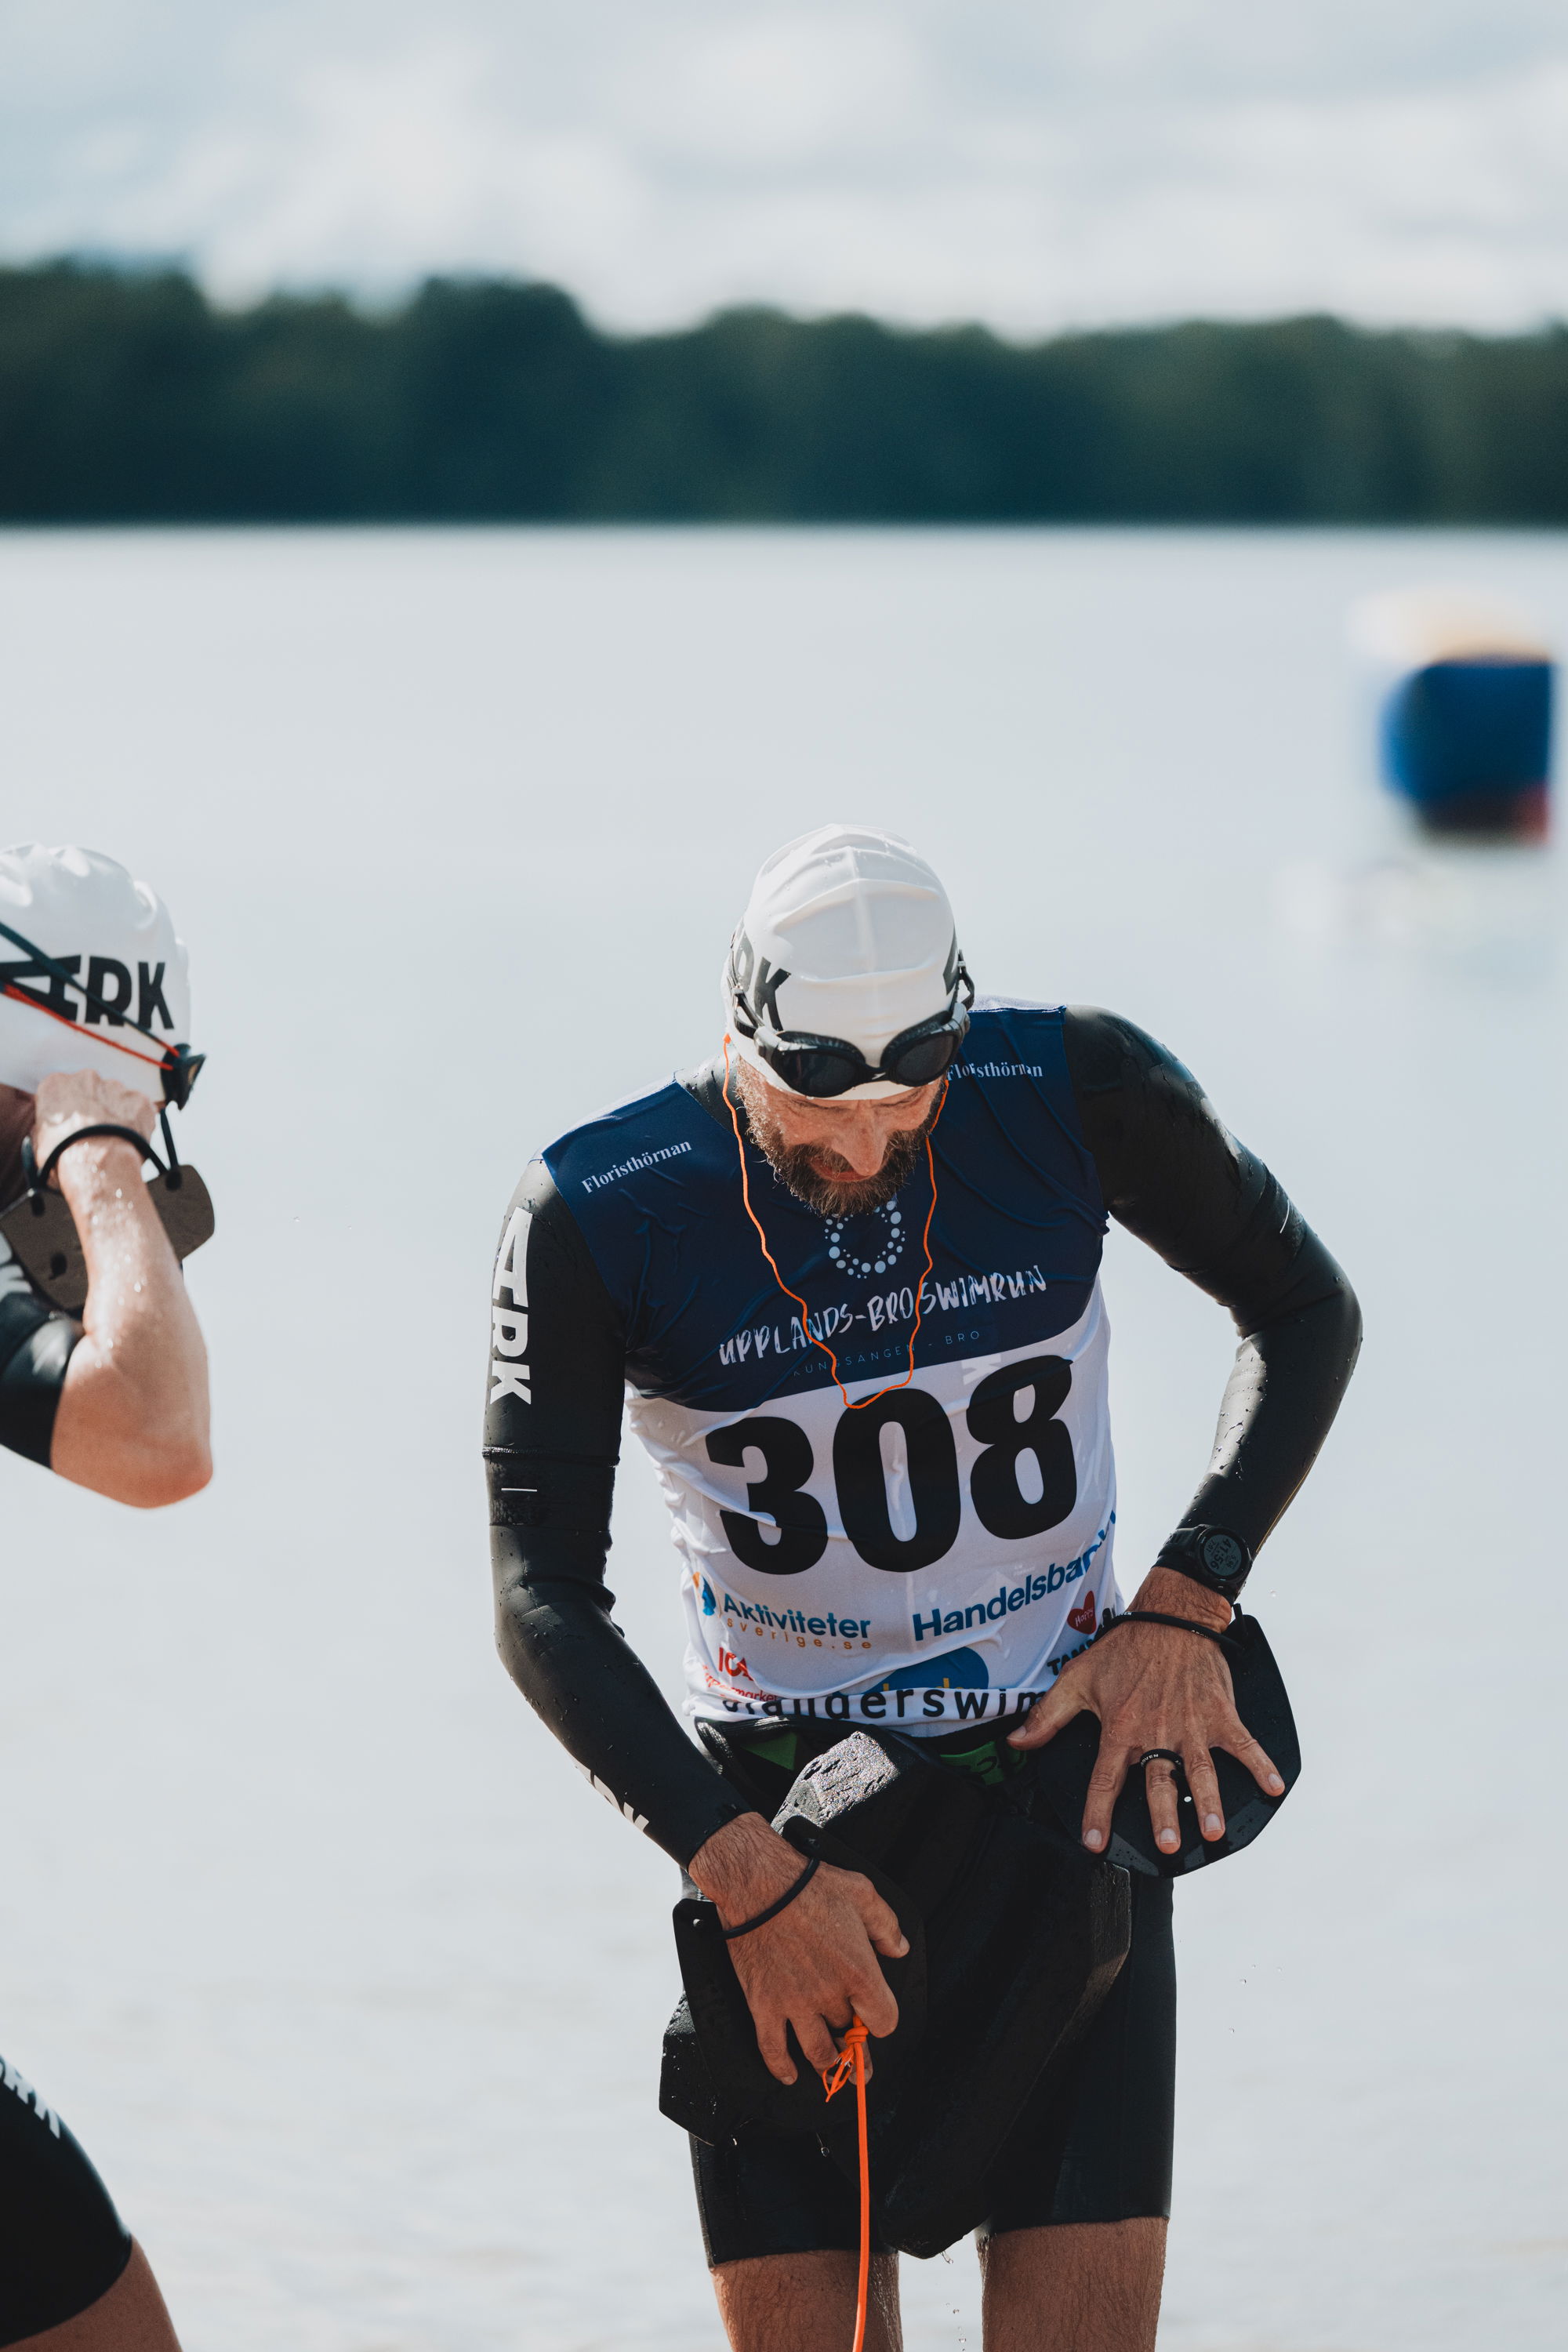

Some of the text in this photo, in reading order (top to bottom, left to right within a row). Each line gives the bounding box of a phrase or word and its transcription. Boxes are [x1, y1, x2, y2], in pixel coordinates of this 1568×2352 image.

[581, 1141, 692, 1194] Floristhörnan
[945, 1330, 979, 1345] BRO
[706, 1355, 1078, 1575] 308
[724, 1593, 871, 1639] Aktiviteter
[727, 1617, 872, 1650] sverige.se
